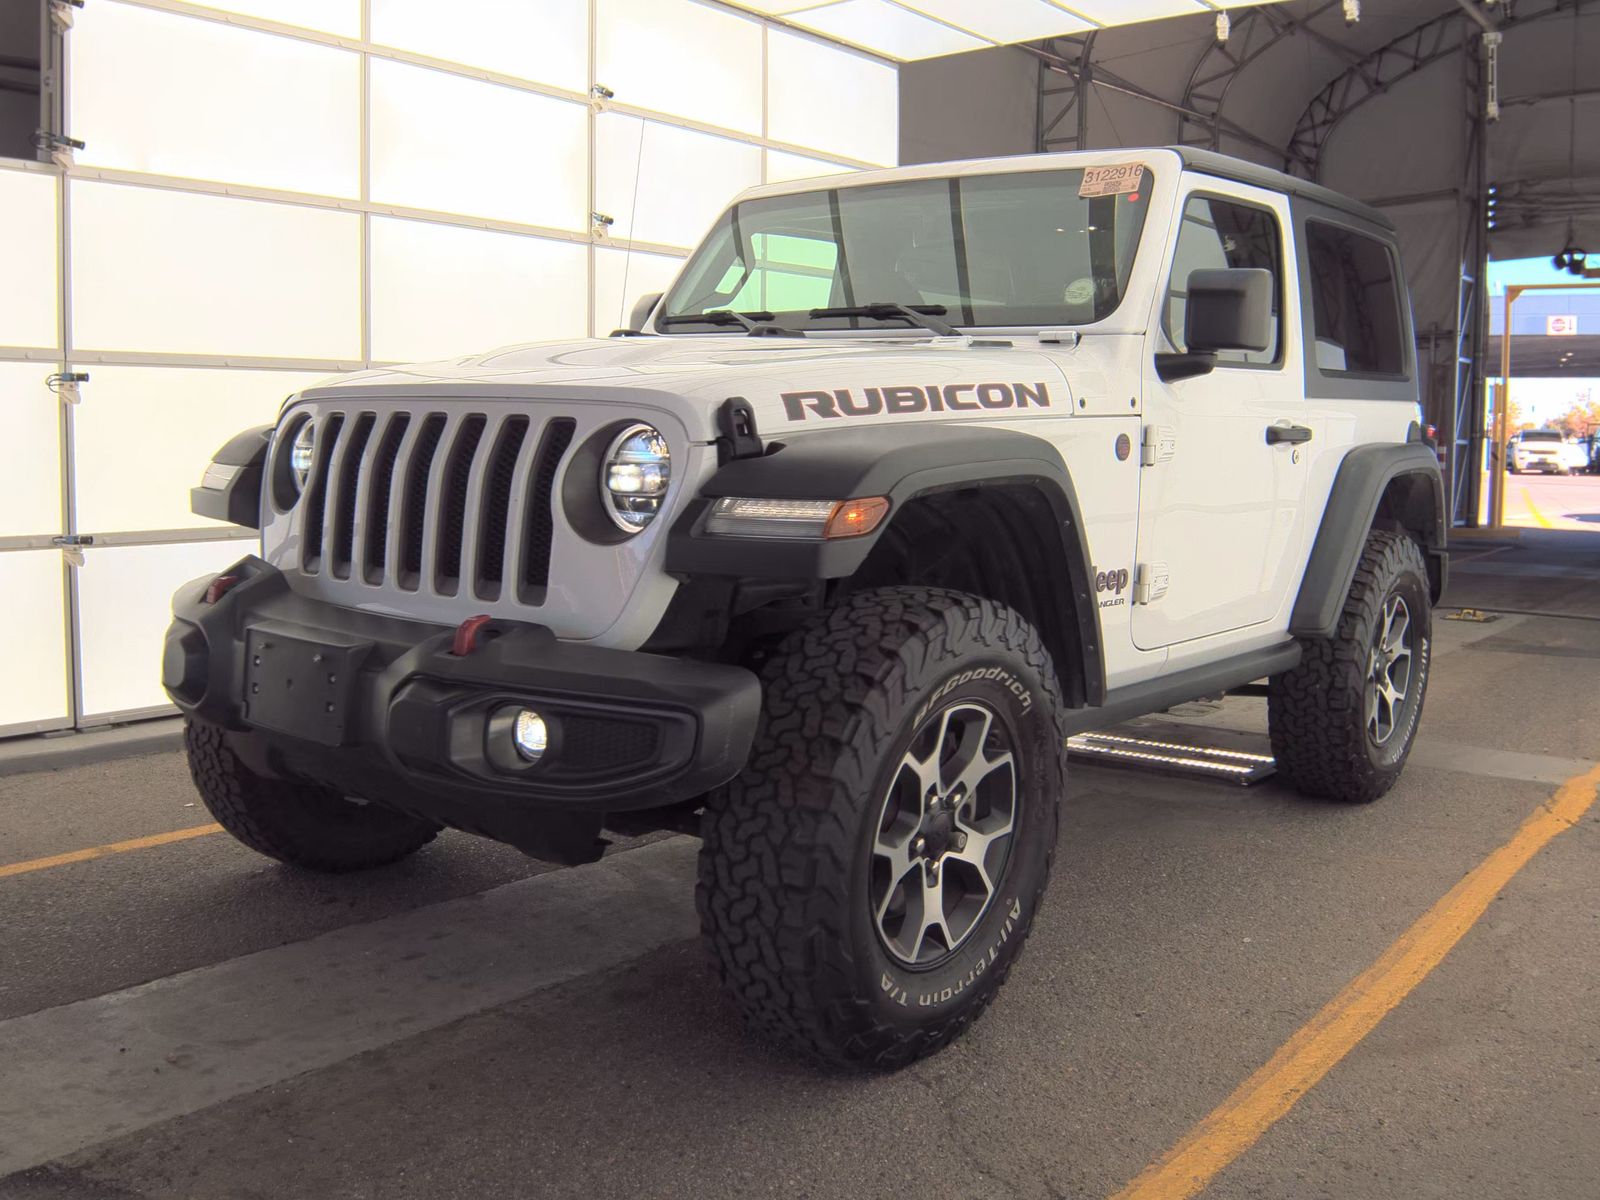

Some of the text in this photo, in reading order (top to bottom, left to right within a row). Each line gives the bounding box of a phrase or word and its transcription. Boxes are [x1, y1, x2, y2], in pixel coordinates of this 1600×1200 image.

[1085, 164, 1144, 184] 3122916
[779, 382, 1050, 421] RUBICON
[1099, 598, 1125, 608] NGLER
[881, 896, 1021, 1007] All-Terrain T/A
